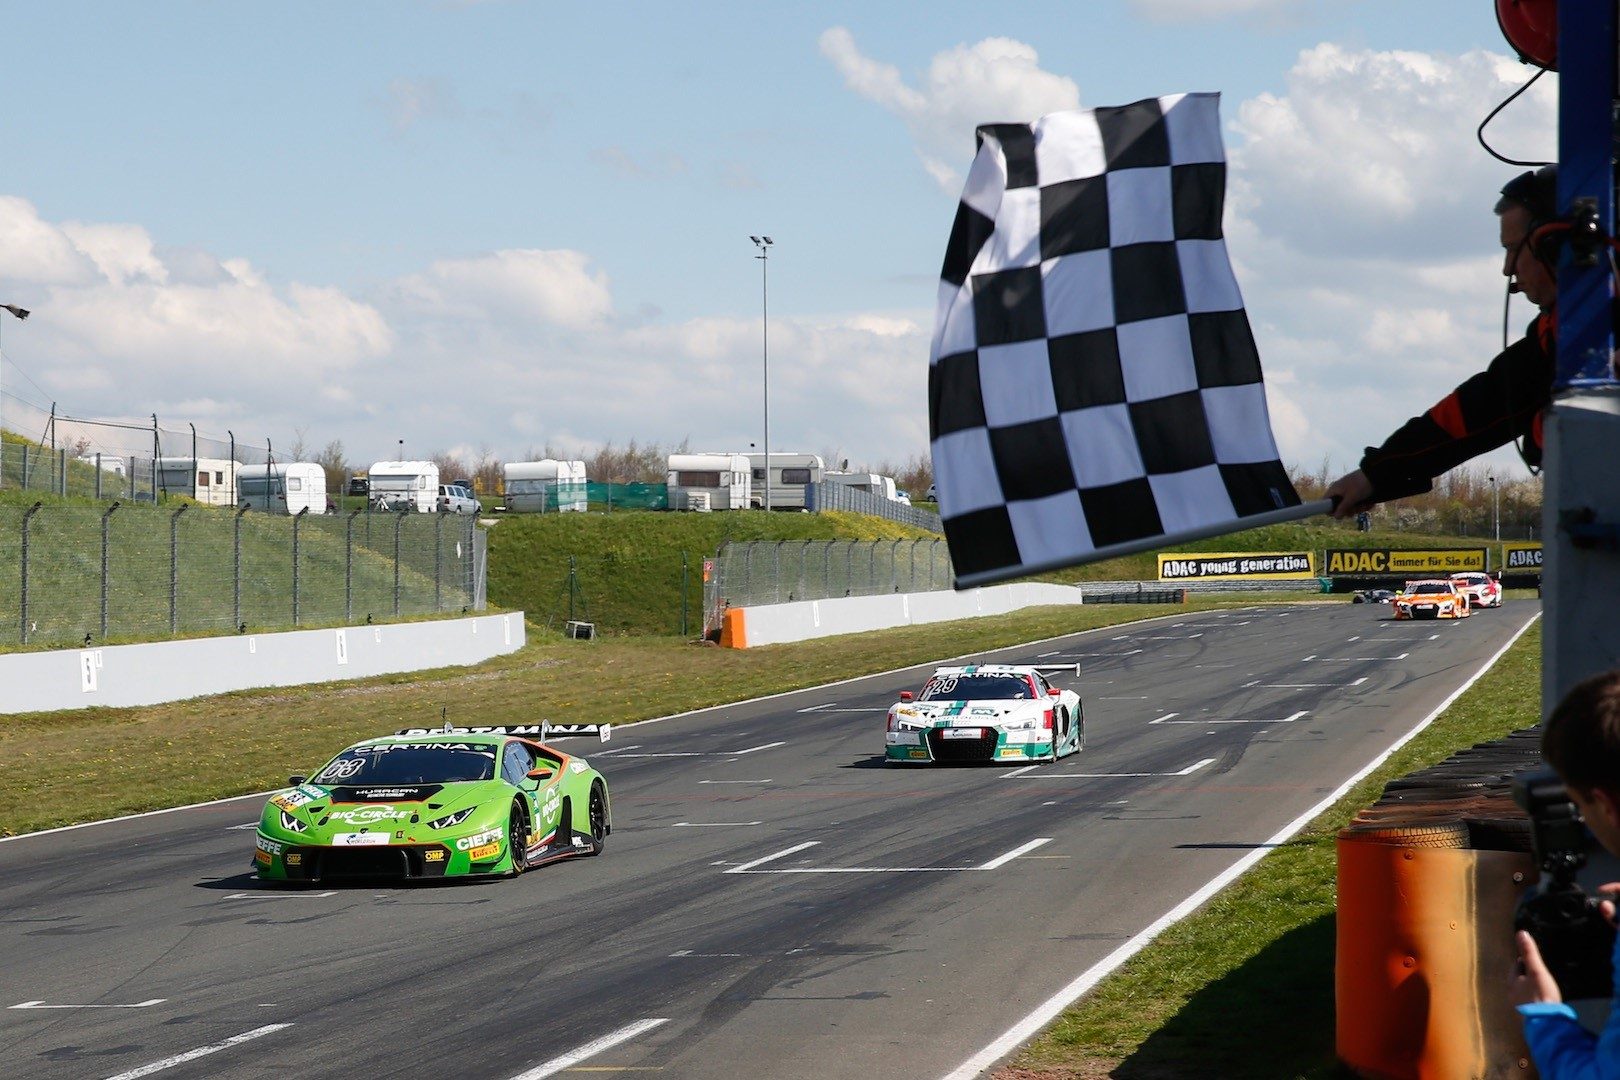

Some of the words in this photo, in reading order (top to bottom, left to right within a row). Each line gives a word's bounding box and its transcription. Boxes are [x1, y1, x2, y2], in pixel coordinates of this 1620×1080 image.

[1329, 552, 1386, 572] ADAC
[1393, 557, 1425, 567] immer
[1428, 555, 1443, 566] für
[1445, 555, 1460, 566] Sie
[1464, 554, 1480, 566] da!
[1508, 550, 1543, 567] ADAC
[1163, 560, 1197, 577] ADAC
[1200, 560, 1238, 576] young
[1240, 556, 1308, 573] generation
[354, 743, 471, 754] CERTINA
[329, 810, 408, 820] BIO-CIRCLE
[425, 851, 444, 860] OMP
